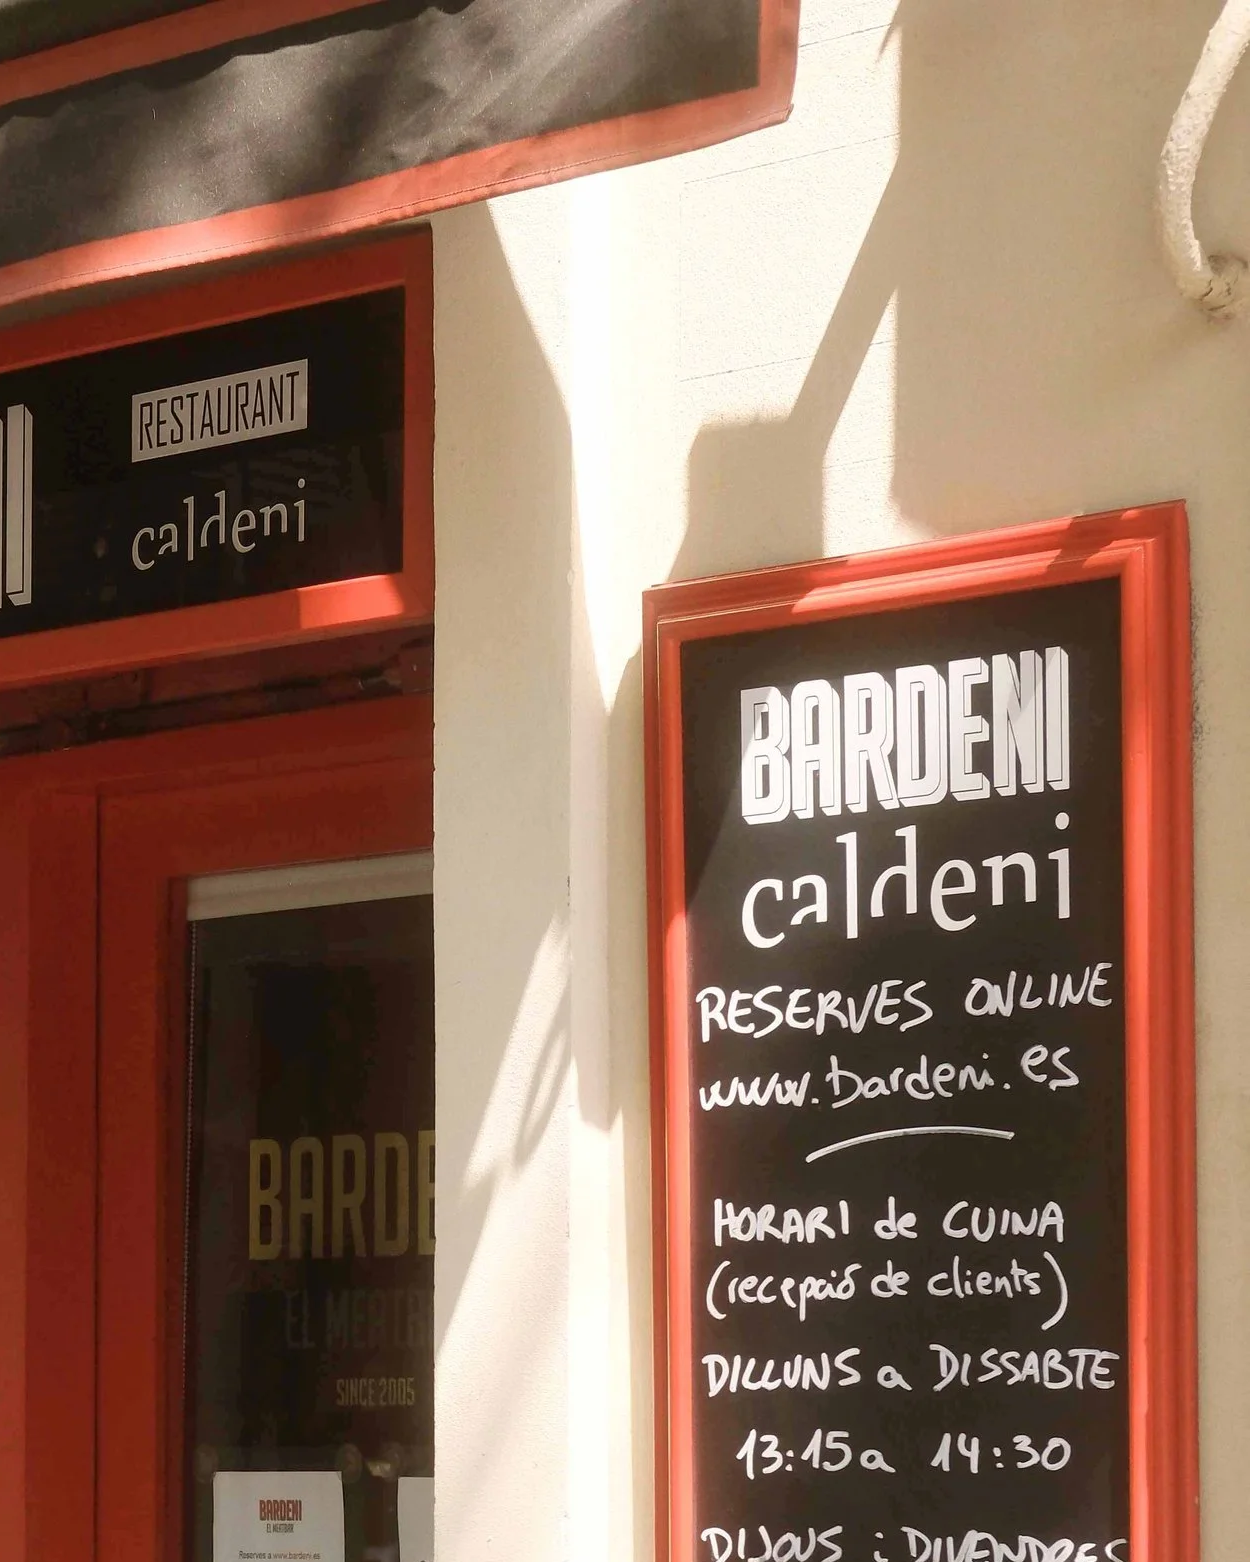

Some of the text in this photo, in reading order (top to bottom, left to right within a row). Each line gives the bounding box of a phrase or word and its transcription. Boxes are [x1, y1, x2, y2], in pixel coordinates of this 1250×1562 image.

[139, 371, 299, 450] RESTAURANT
[132, 478, 305, 571] caldeni
[740, 646, 1070, 825] BARDENI
[741, 812, 1071, 949] caldeni
[695, 962, 1113, 1042] RESERVES ONLINE
[713, 1196, 1065, 1247] HORARI de CUINA
[870, 1260, 911, 1298] de
[927, 1251, 1068, 1331] clients)
[336, 1377, 415, 1408] SINCE 2005
[702, 1344, 1120, 1397] DILLUNS a DISSABTE
[735, 1428, 1072, 1479] 13:15 a 14:30
[259, 1499, 302, 1521] BARDENI
